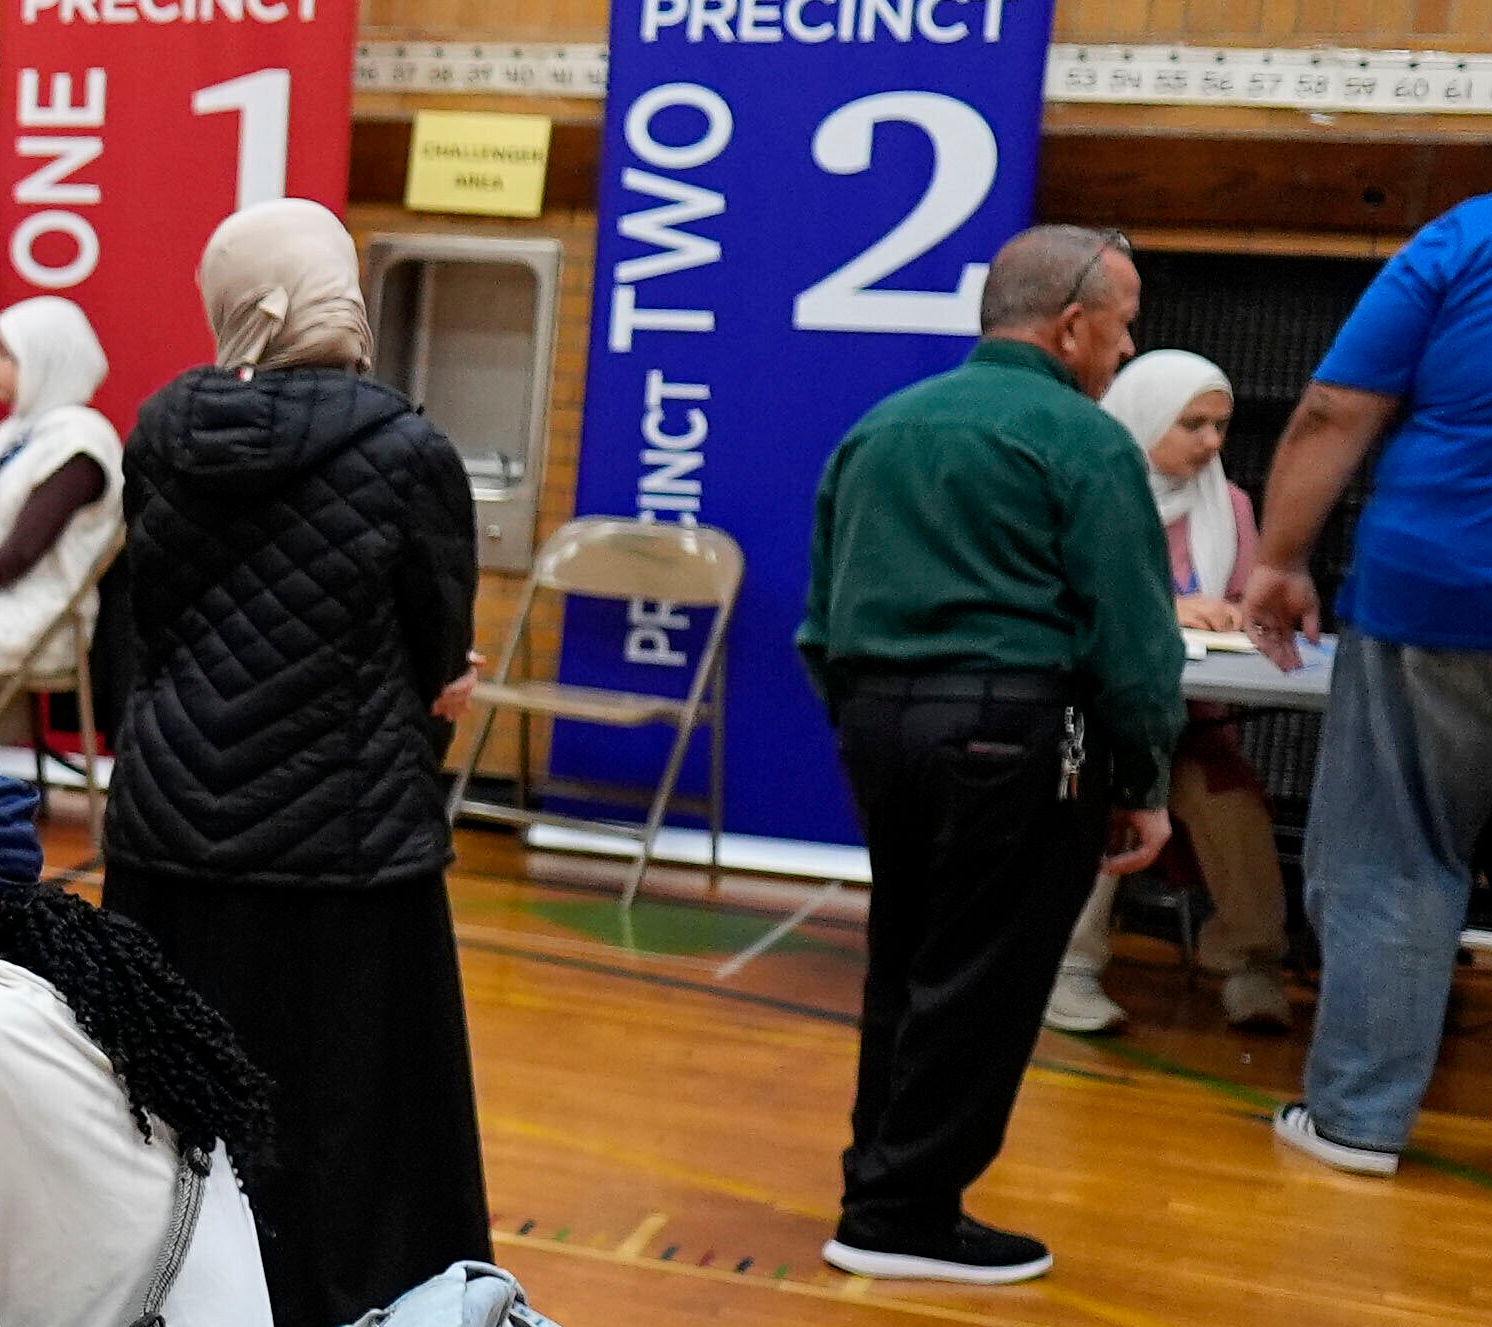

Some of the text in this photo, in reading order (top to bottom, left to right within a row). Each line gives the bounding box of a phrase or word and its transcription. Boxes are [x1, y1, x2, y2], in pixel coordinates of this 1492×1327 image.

[191, 68, 291, 213] 1
[422, 140, 545, 163] CHALLENGER
[1065, 68, 1473, 103] 53 54 55 56 57 58 59 60 61
[9, 67, 107, 290] ONE
[455, 173, 504, 191] AREA
[792, 90, 998, 336] 2
[608, 81, 735, 666] PRINCT TWO
